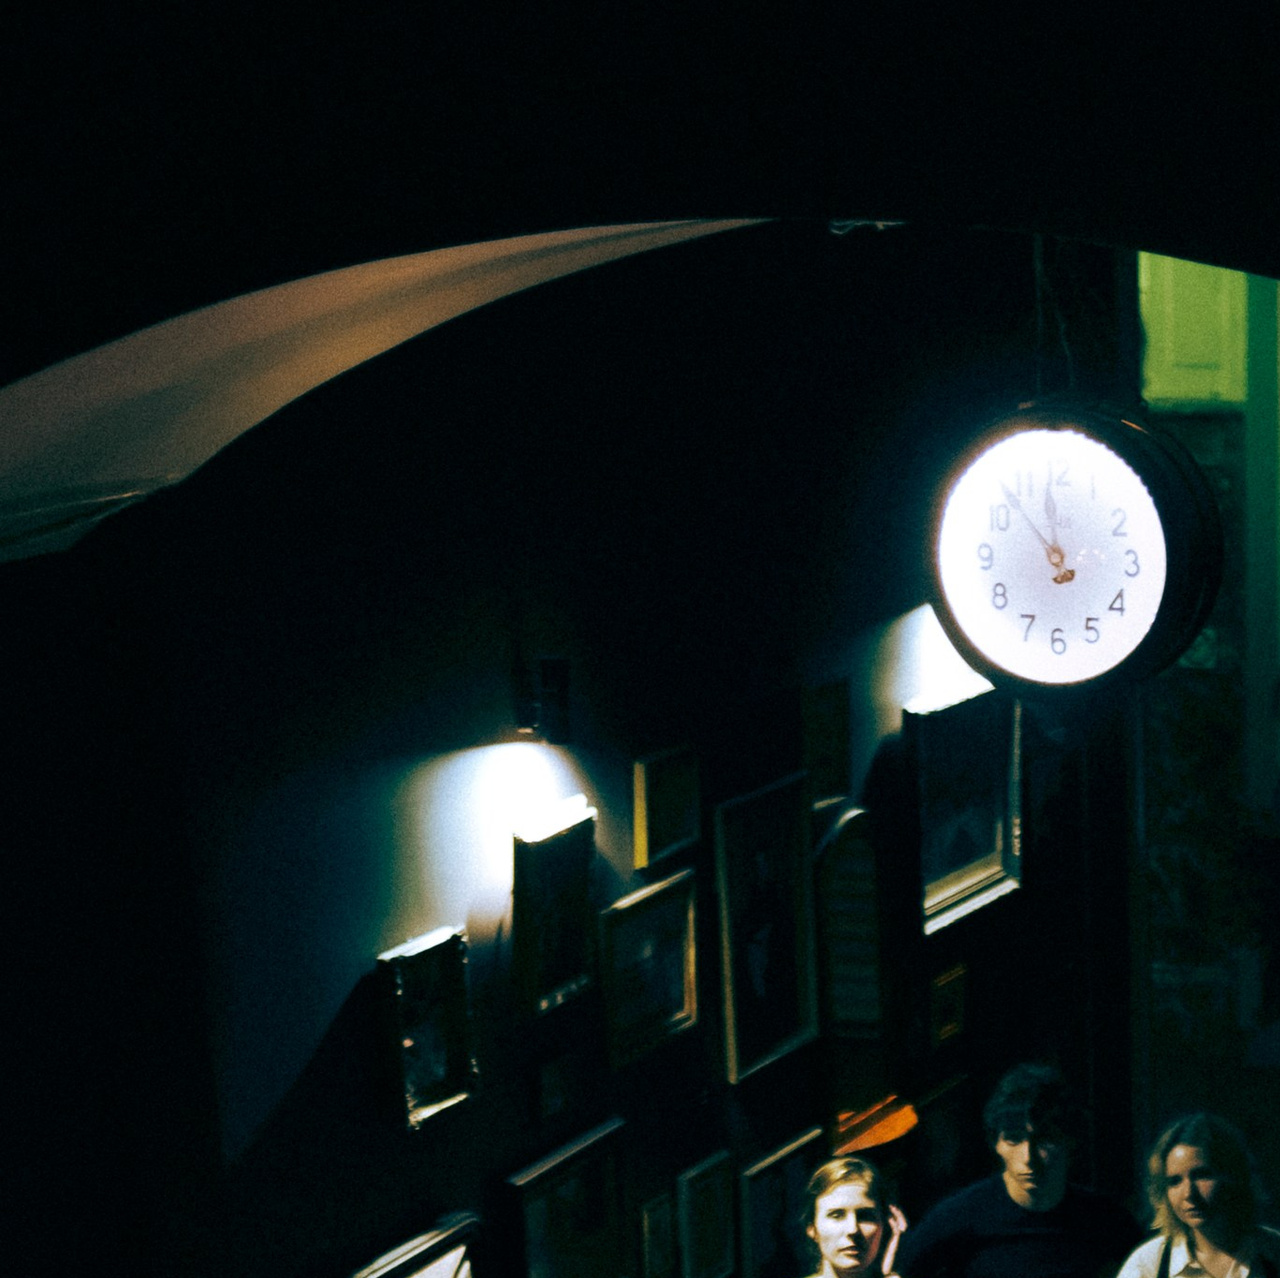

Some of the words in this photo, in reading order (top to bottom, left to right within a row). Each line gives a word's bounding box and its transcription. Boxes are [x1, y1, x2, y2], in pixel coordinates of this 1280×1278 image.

[989, 504, 1010, 532] 10
[1111, 507, 1128, 537] 2
[977, 543, 994, 571] 9
[1124, 549, 1141, 578] 3
[991, 582, 1008, 610] 8
[1107, 588, 1126, 617] 4
[1020, 613, 1036, 642] 7
[1050, 627, 1067, 655] 6
[1084, 616, 1101, 644] 5
